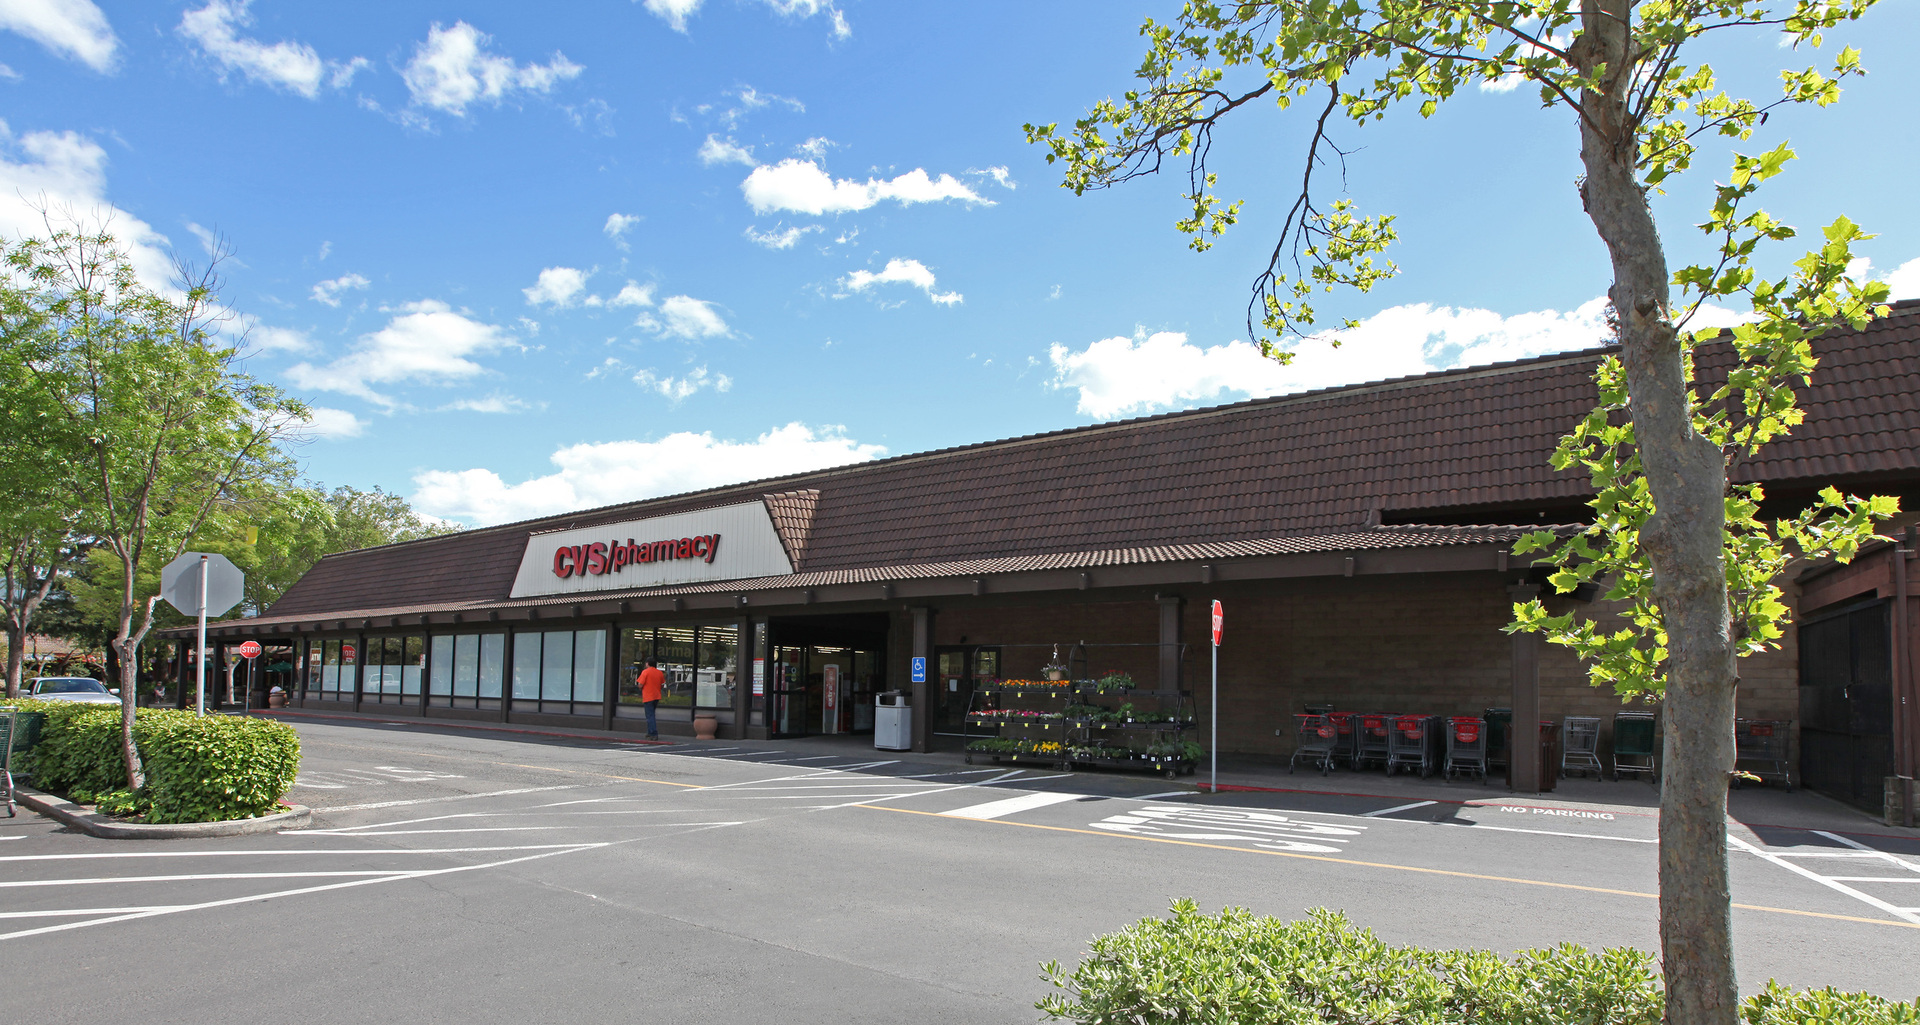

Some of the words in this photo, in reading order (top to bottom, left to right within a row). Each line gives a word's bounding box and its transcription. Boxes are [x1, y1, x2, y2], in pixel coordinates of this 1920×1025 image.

[554, 534, 721, 578] CVS/pharmacy
[1213, 615, 1223, 632] STOP
[311, 653, 321, 661] ATM
[638, 642, 694, 658] Pharma
[1533, 808, 1615, 820] PARKING
[1088, 806, 1368, 853] STOP
